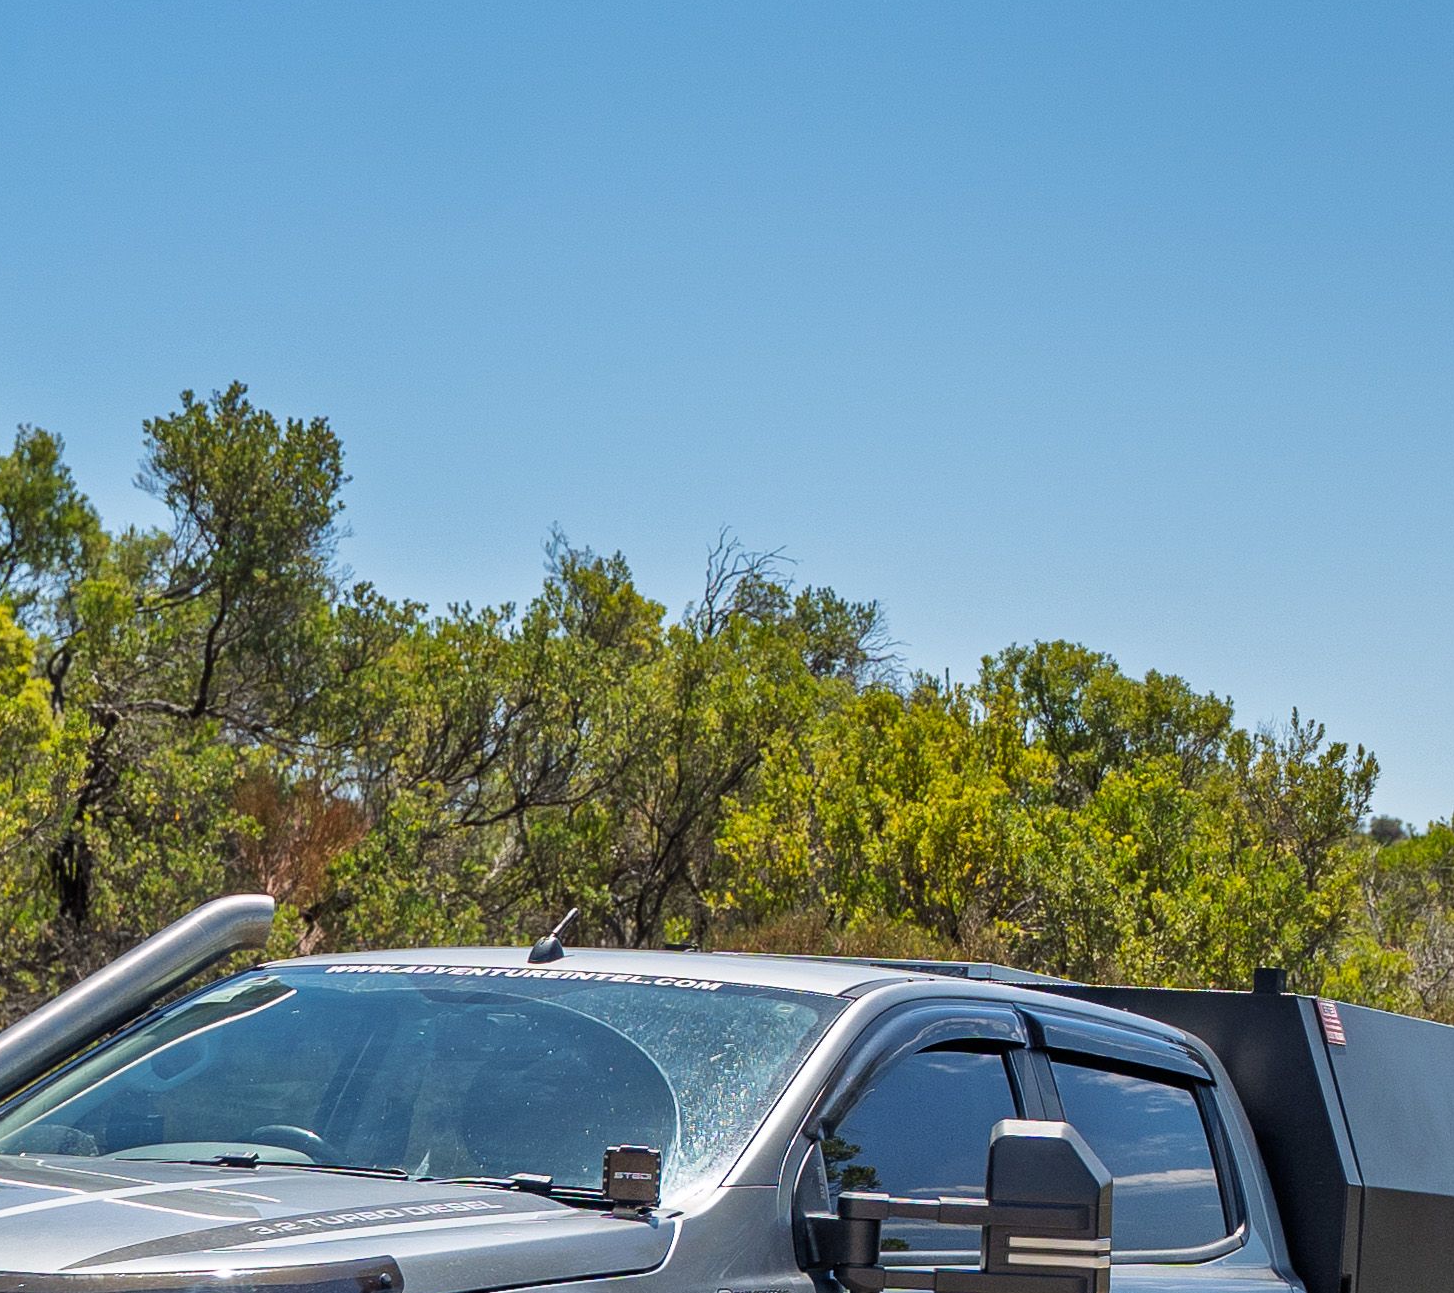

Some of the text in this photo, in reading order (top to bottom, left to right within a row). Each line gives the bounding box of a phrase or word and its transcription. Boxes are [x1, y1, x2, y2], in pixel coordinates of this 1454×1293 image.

[325, 965, 724, 992] WWW.ADVENTUREINTEL.COM
[248, 1200, 506, 1236] 3.2 TURBO DIESEL
